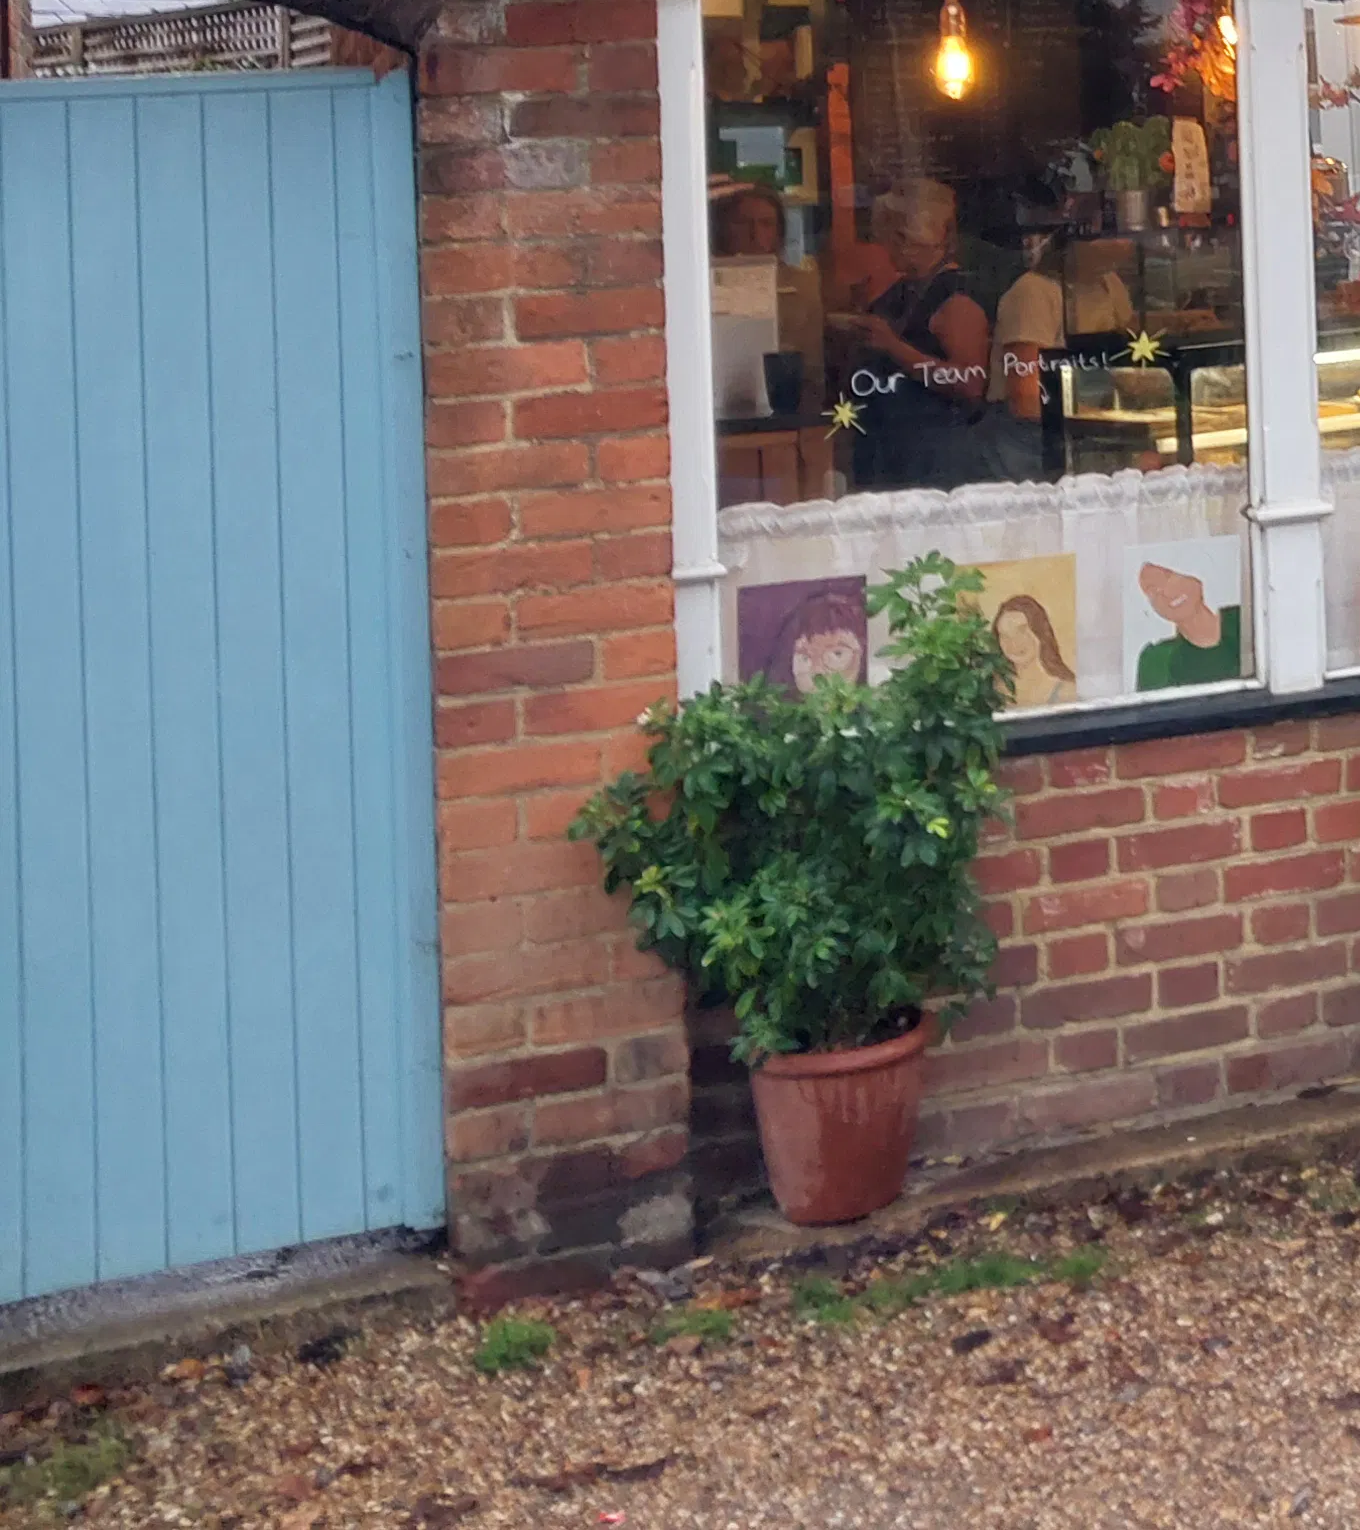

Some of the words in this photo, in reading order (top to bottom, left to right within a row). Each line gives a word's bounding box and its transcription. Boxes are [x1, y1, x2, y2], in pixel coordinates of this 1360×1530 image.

[851, 369, 905, 398] Our
[913, 360, 987, 389] Team
[1003, 351, 1112, 377] Portraits!
